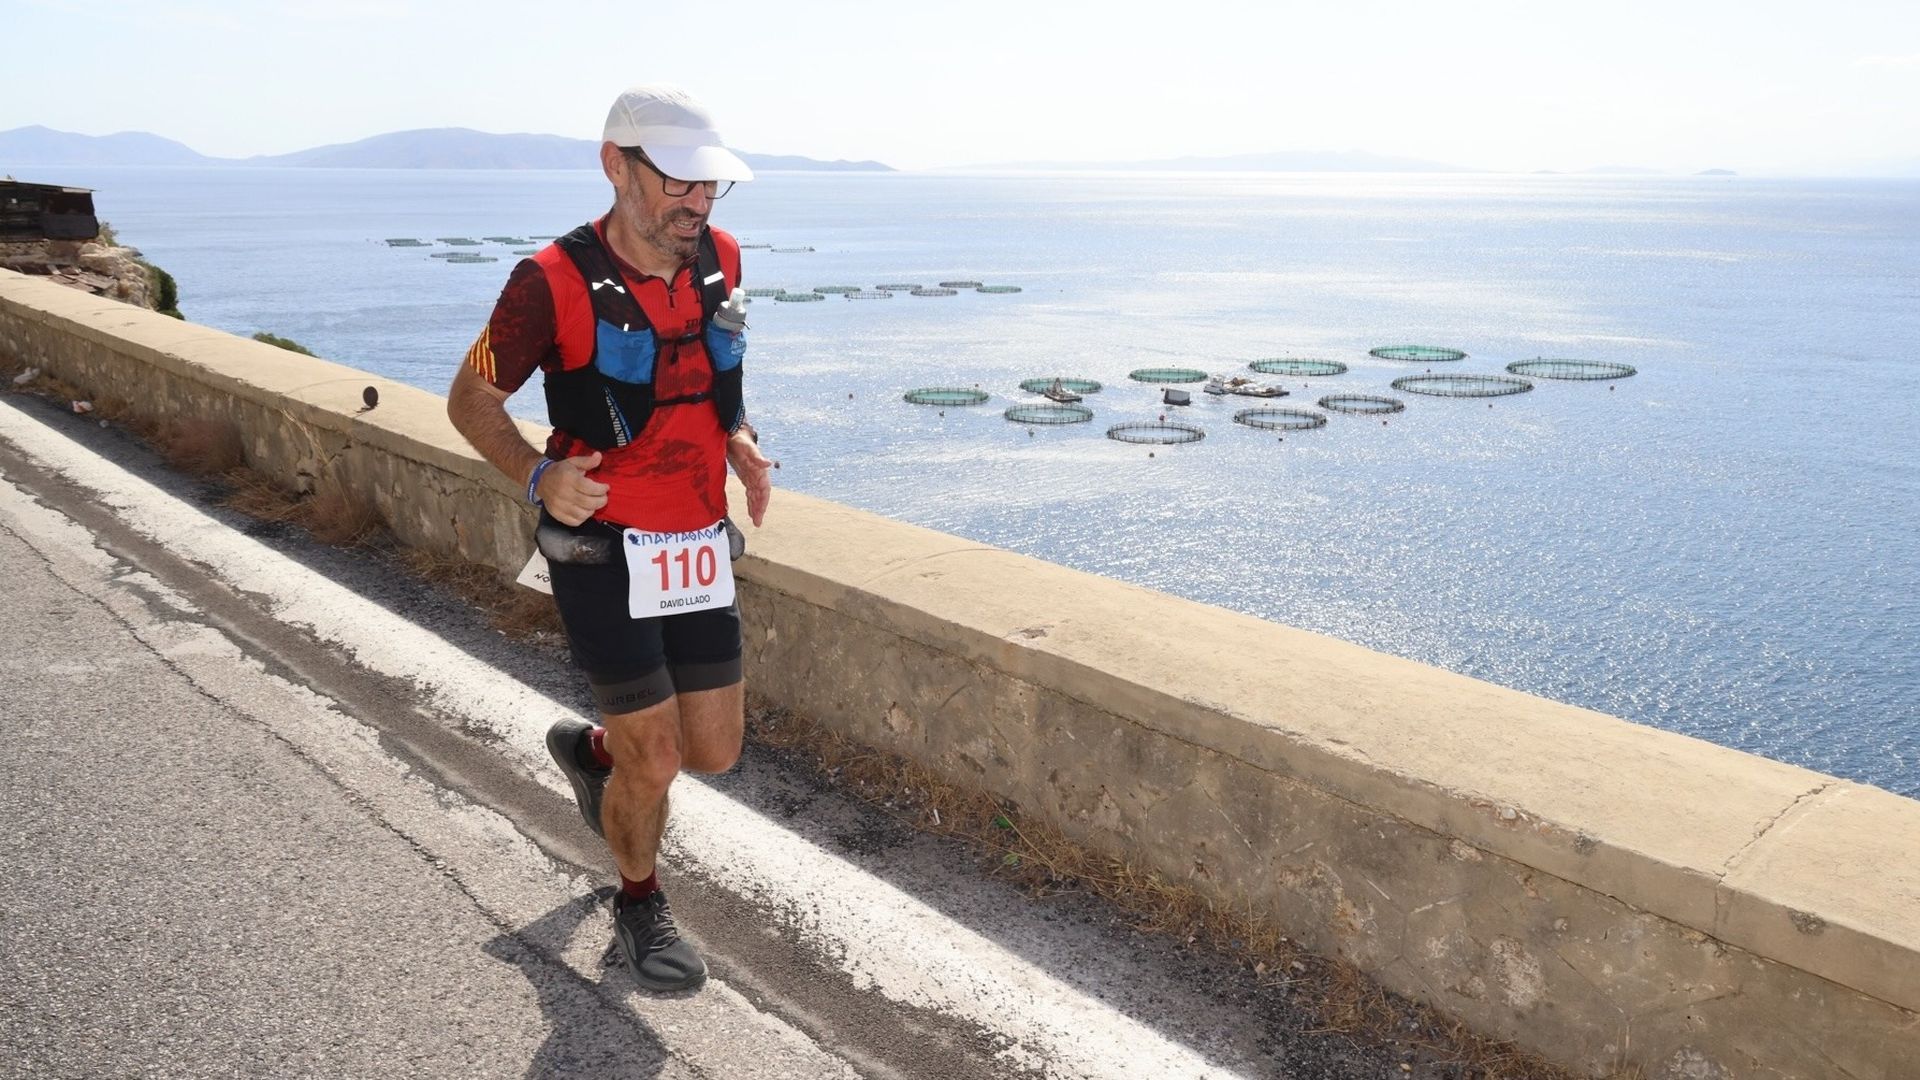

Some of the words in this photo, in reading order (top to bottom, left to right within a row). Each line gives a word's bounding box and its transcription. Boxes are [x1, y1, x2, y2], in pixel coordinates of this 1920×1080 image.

[651, 545, 717, 591] 110
[660, 598, 685, 609] DAVID
[685, 594, 711, 606] LLADO
